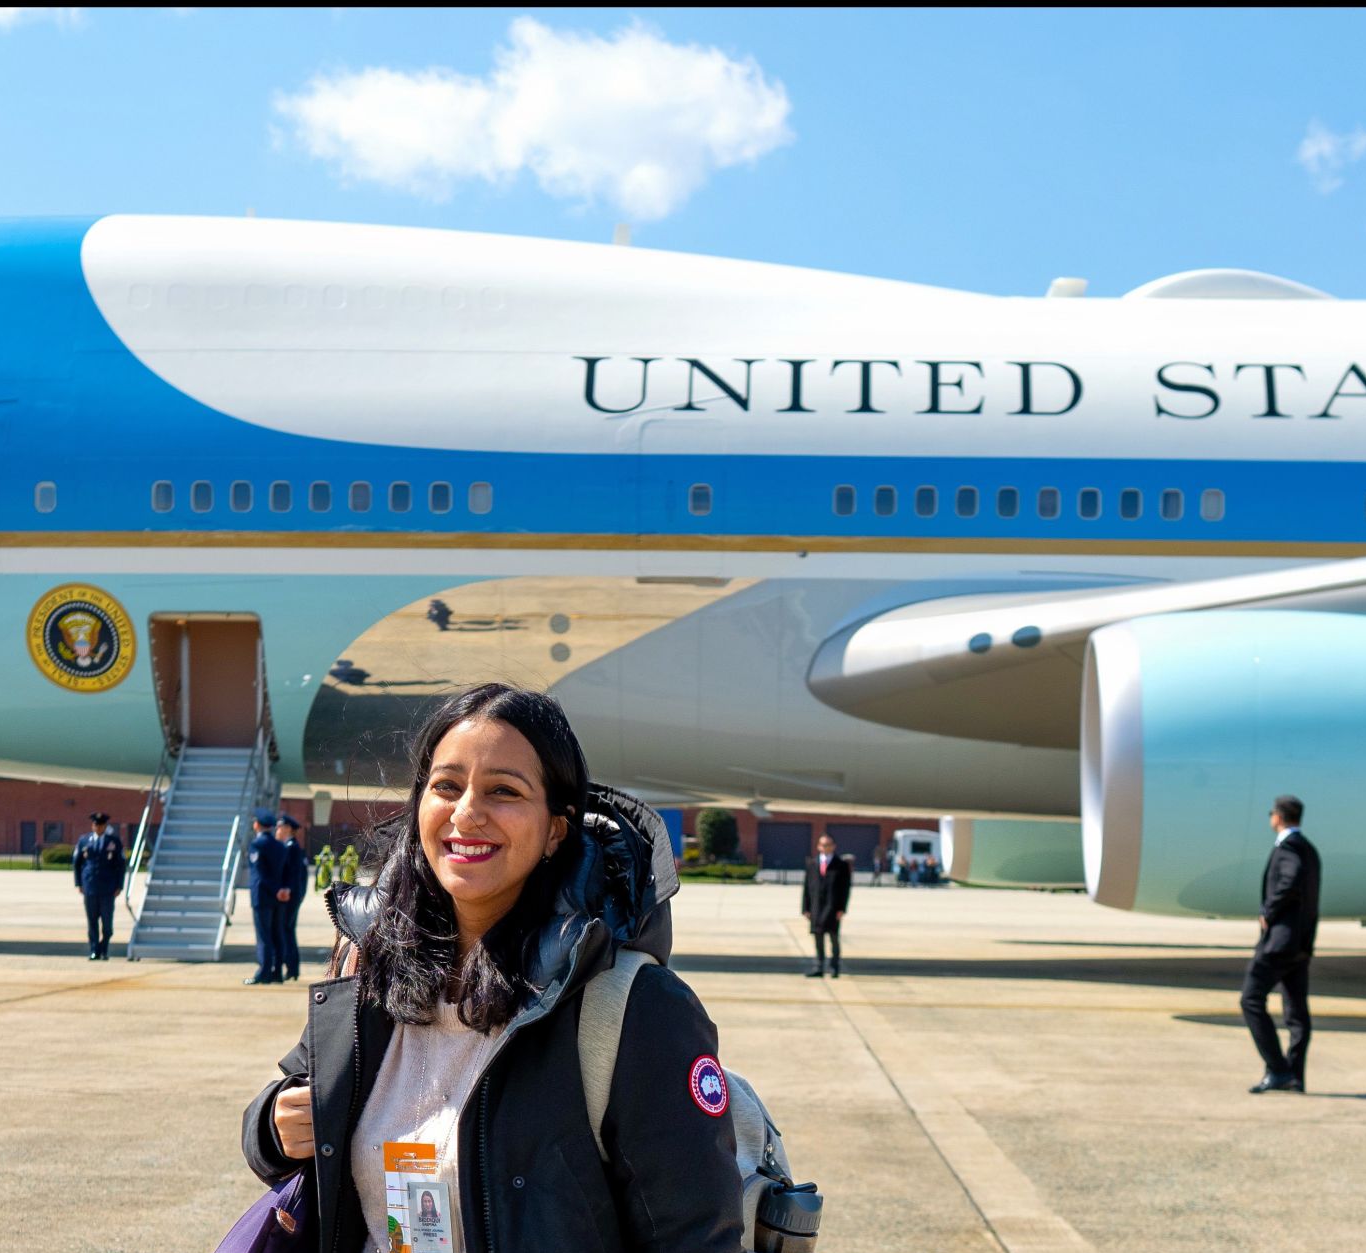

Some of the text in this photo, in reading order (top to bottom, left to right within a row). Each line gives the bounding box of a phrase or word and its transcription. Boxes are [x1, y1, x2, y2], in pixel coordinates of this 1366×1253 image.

[572, 355, 1084, 416] UNITED
[34, 590, 74, 638] PRESIDENT
[106, 601, 131, 648] UNITED
